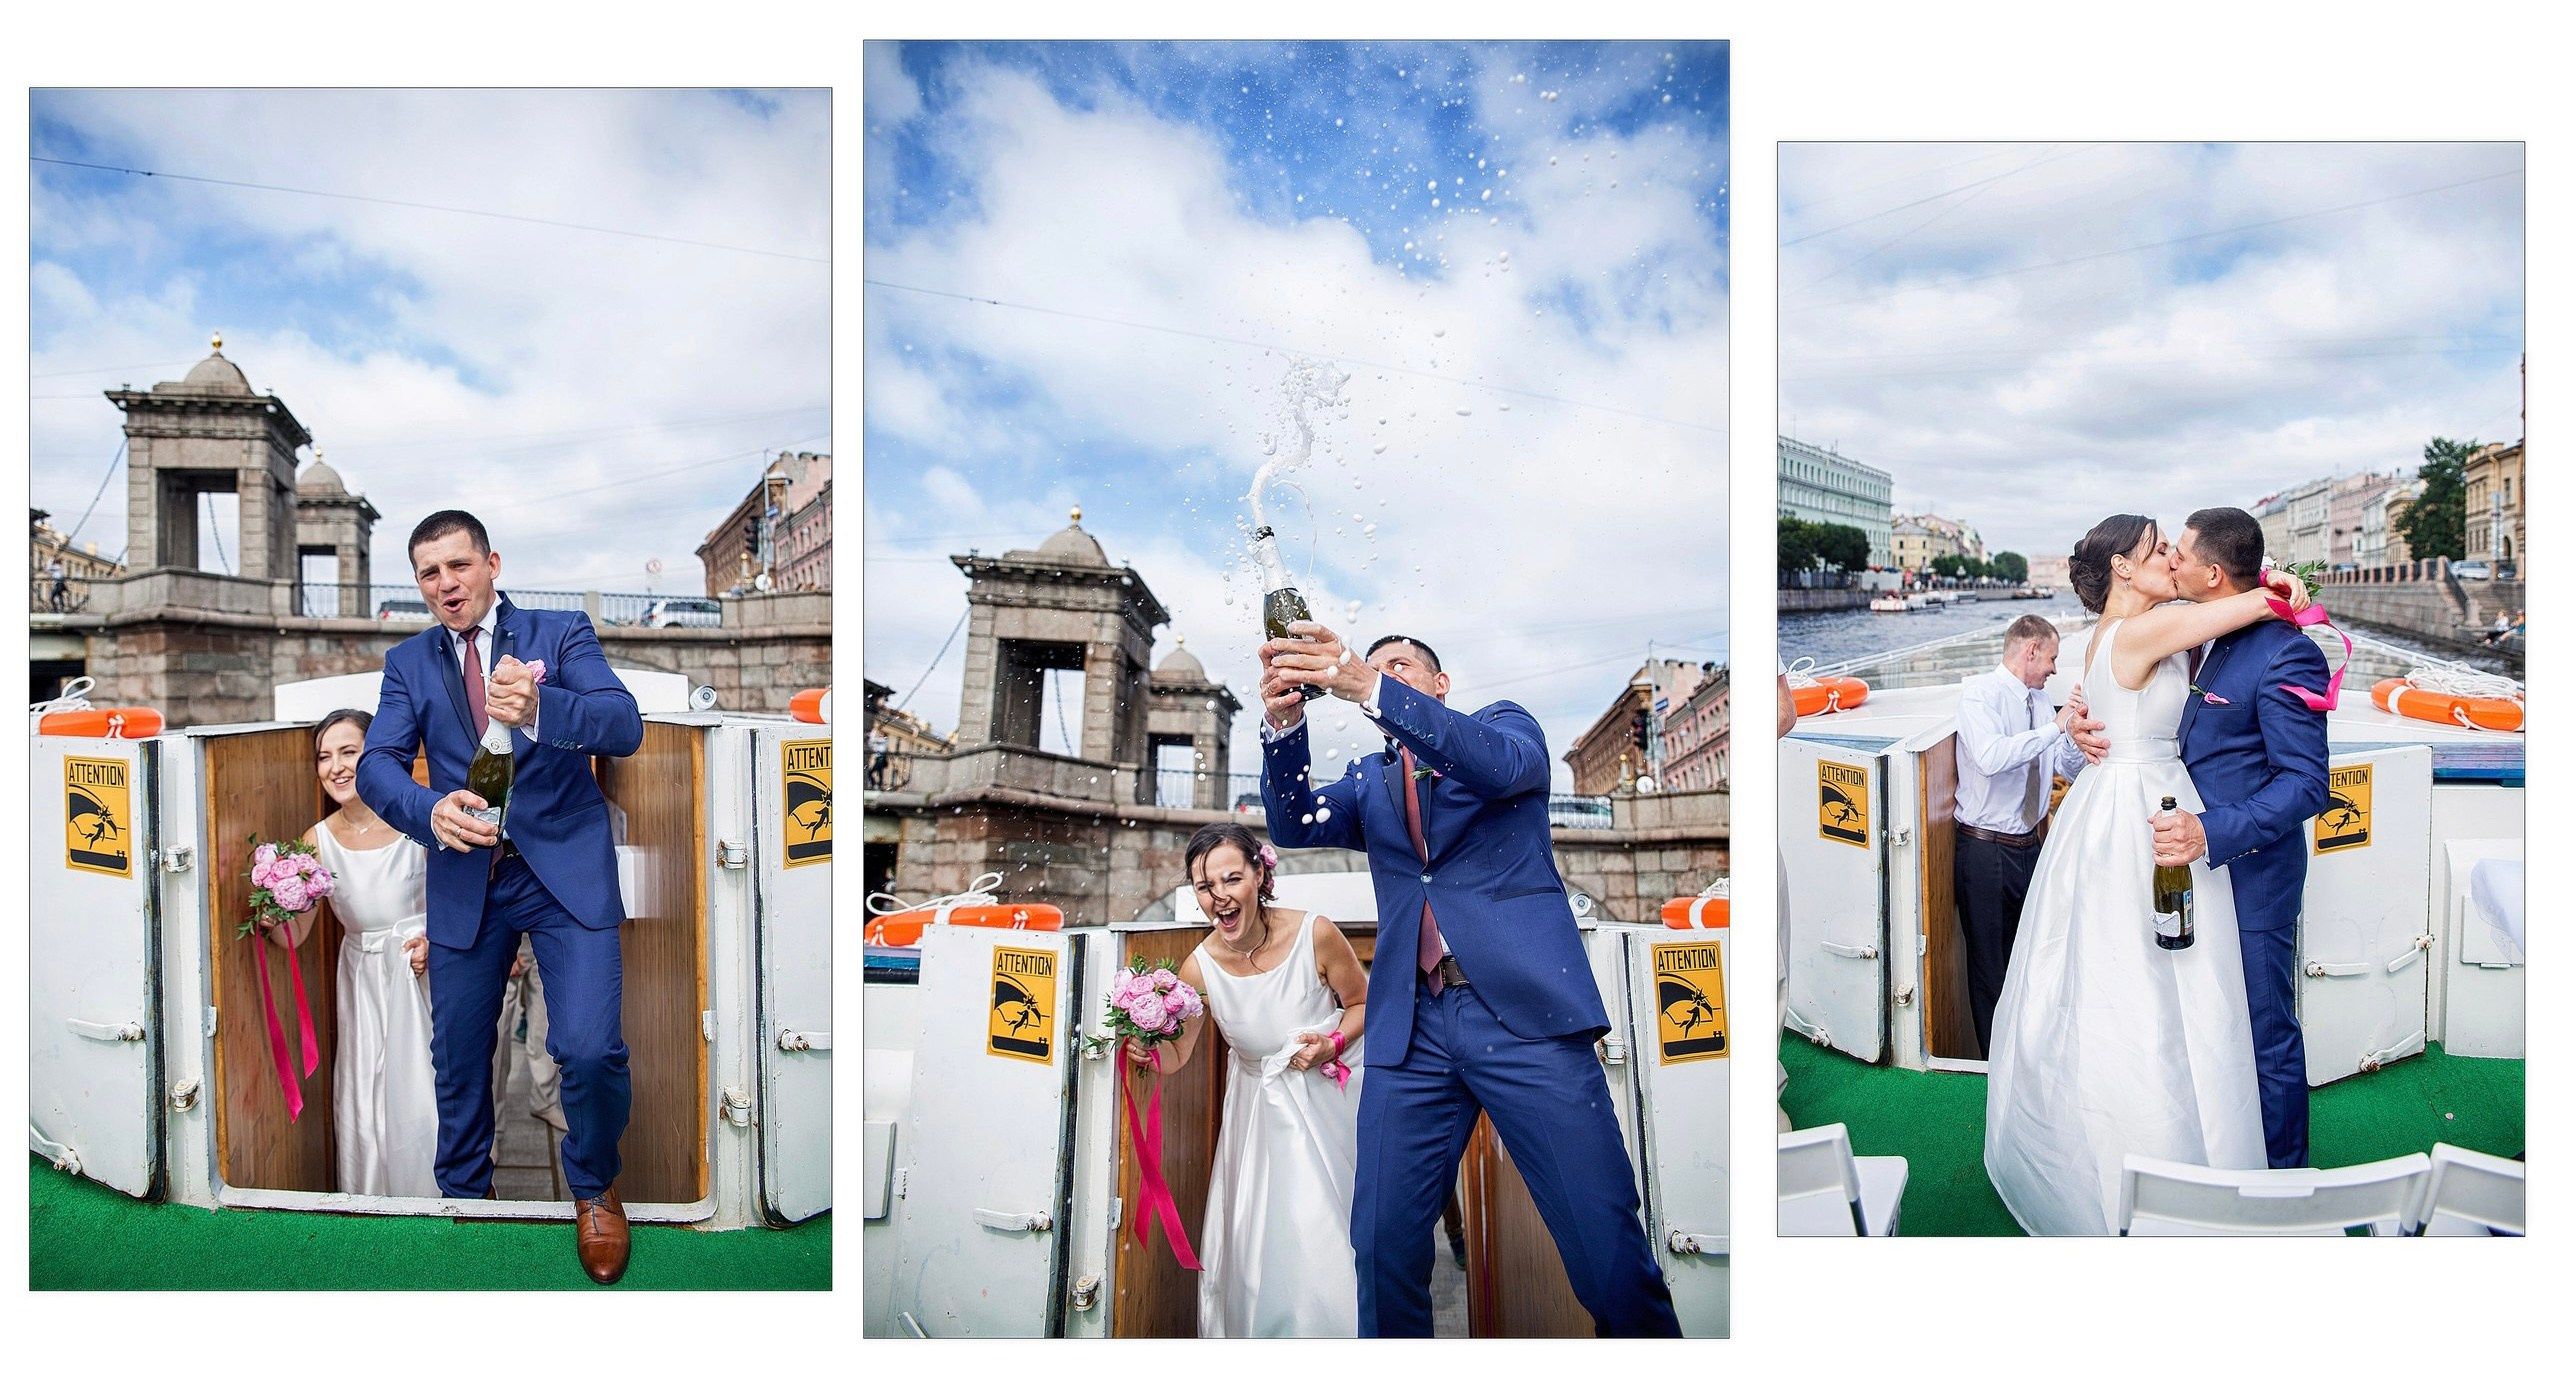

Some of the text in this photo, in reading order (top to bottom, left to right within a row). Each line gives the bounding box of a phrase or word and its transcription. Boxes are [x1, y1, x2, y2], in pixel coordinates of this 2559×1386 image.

[787, 746, 831, 770] ATTENT
[69, 763, 124, 786] ATTENTION
[1822, 765, 1865, 786] ATTENTION
[2330, 769, 2368, 787] TENTION
[997, 953, 1053, 976] ATTENTION
[1658, 948, 1717, 970] ATTENTION
